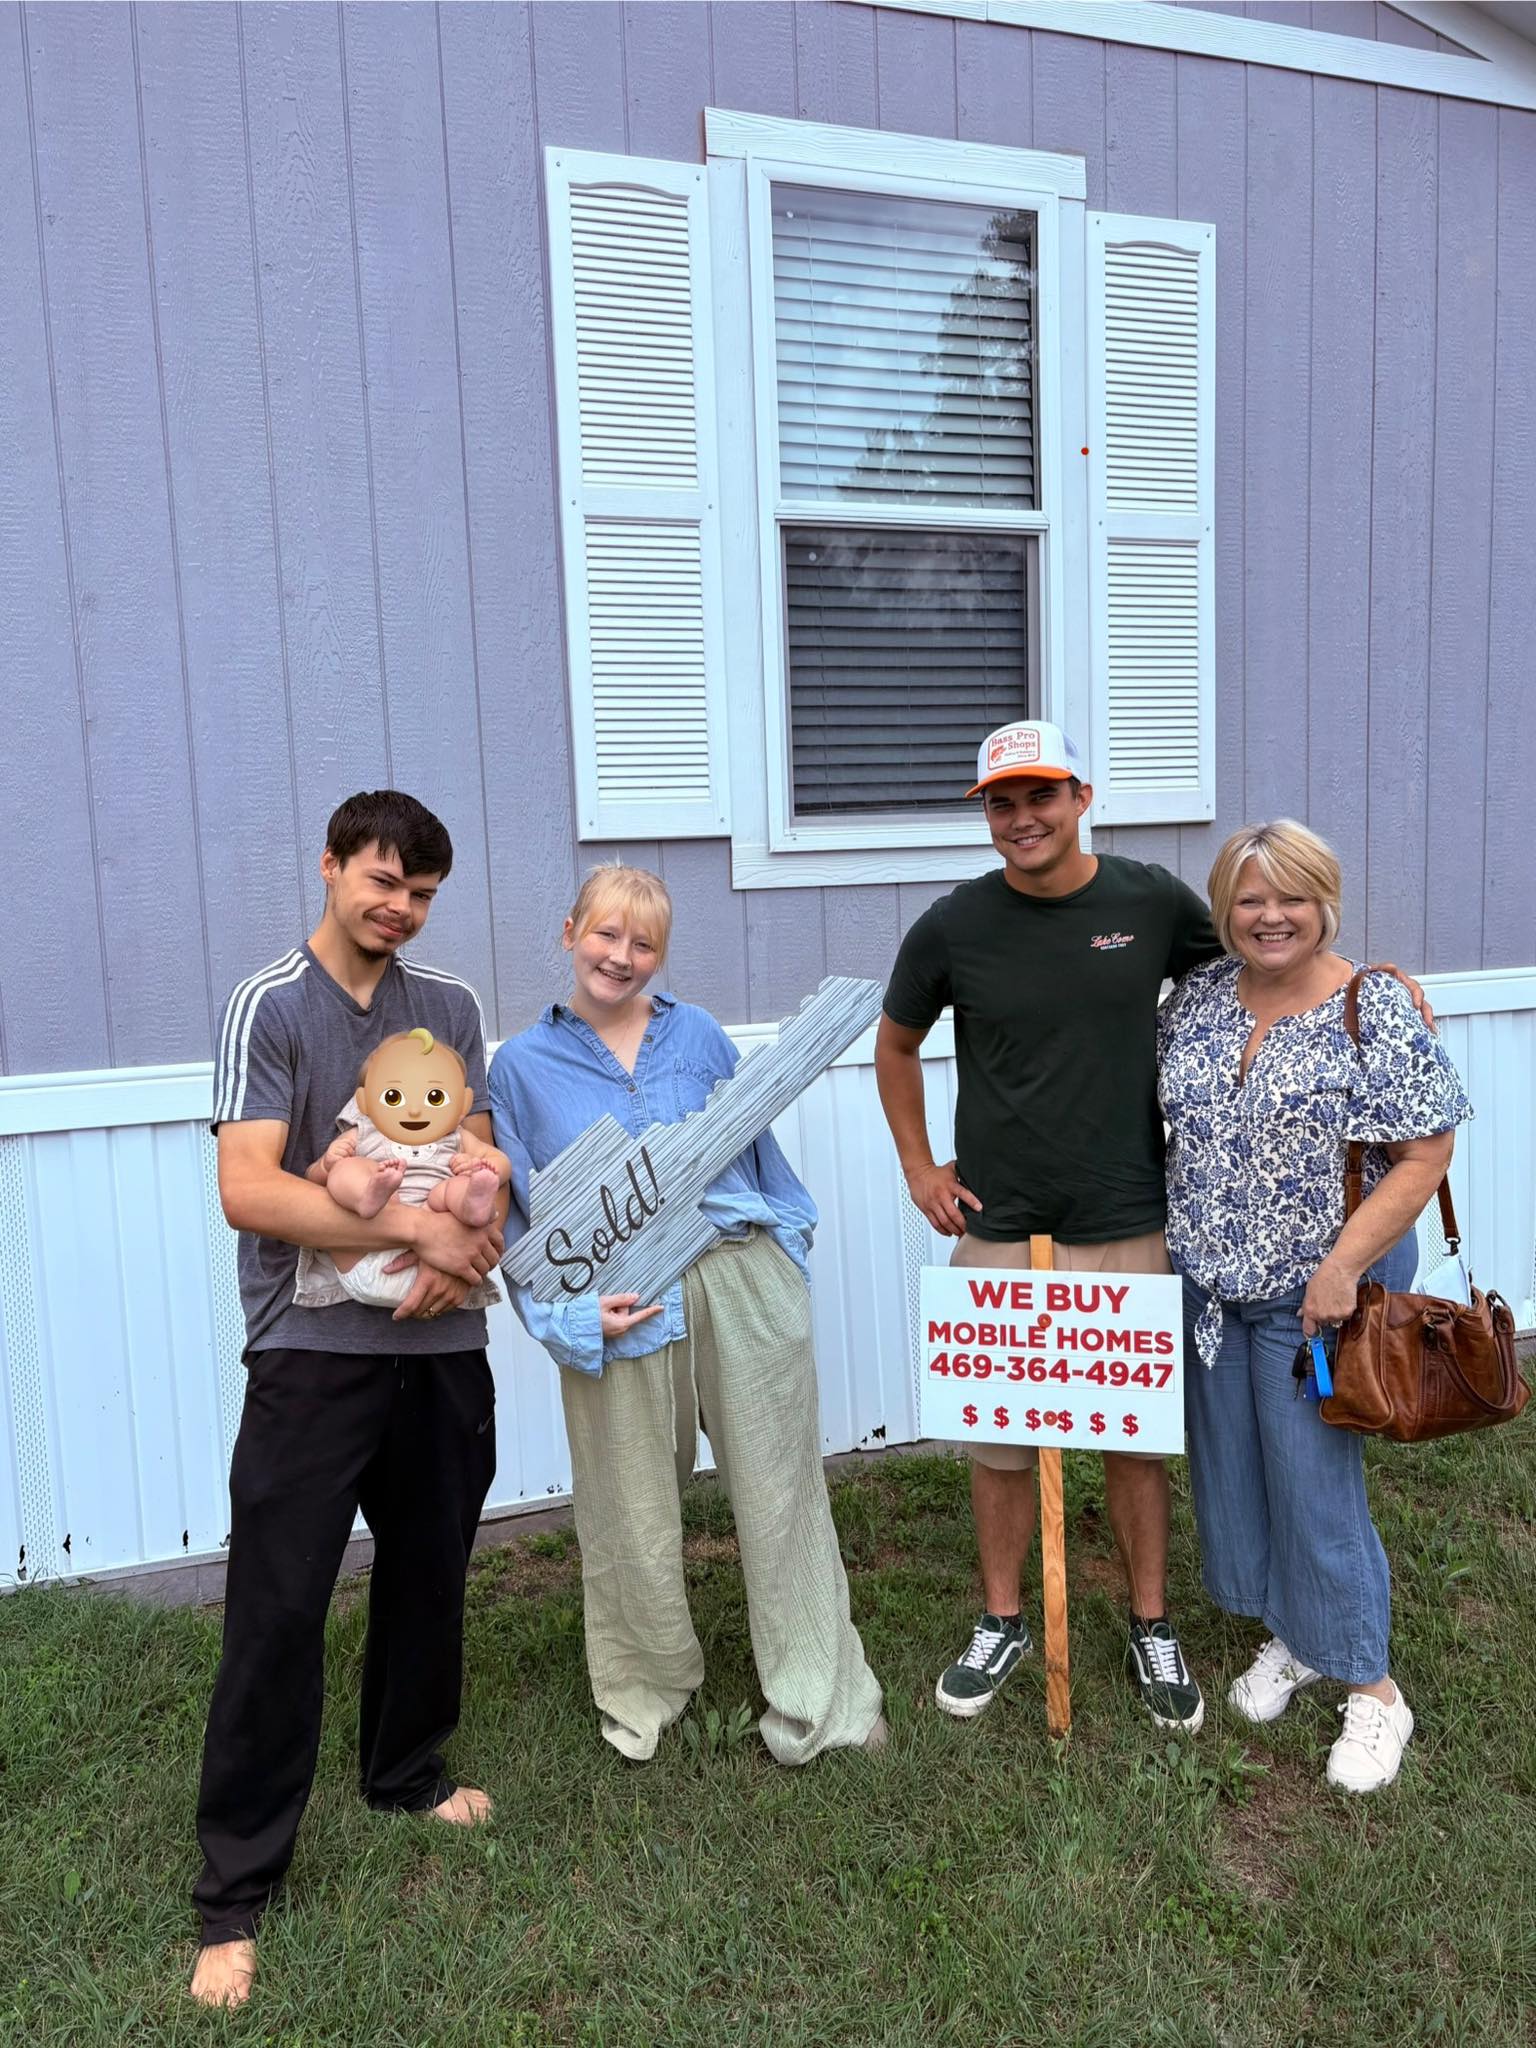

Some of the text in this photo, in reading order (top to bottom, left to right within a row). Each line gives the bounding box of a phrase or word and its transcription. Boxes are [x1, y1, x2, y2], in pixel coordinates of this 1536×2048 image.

[991, 731, 1035, 747] Bass Pro
[1007, 740, 1036, 750] Shops
[1090, 935, 1112, 948] Lake
[1110, 932, 1135, 944] Como
[545, 1145, 665, 1293] Sold!
[967, 1280, 1130, 1313] WE BUY
[928, 1321, 1174, 1355] MOBILE HOMES
[929, 1352, 1173, 1388] 469-364-4947
